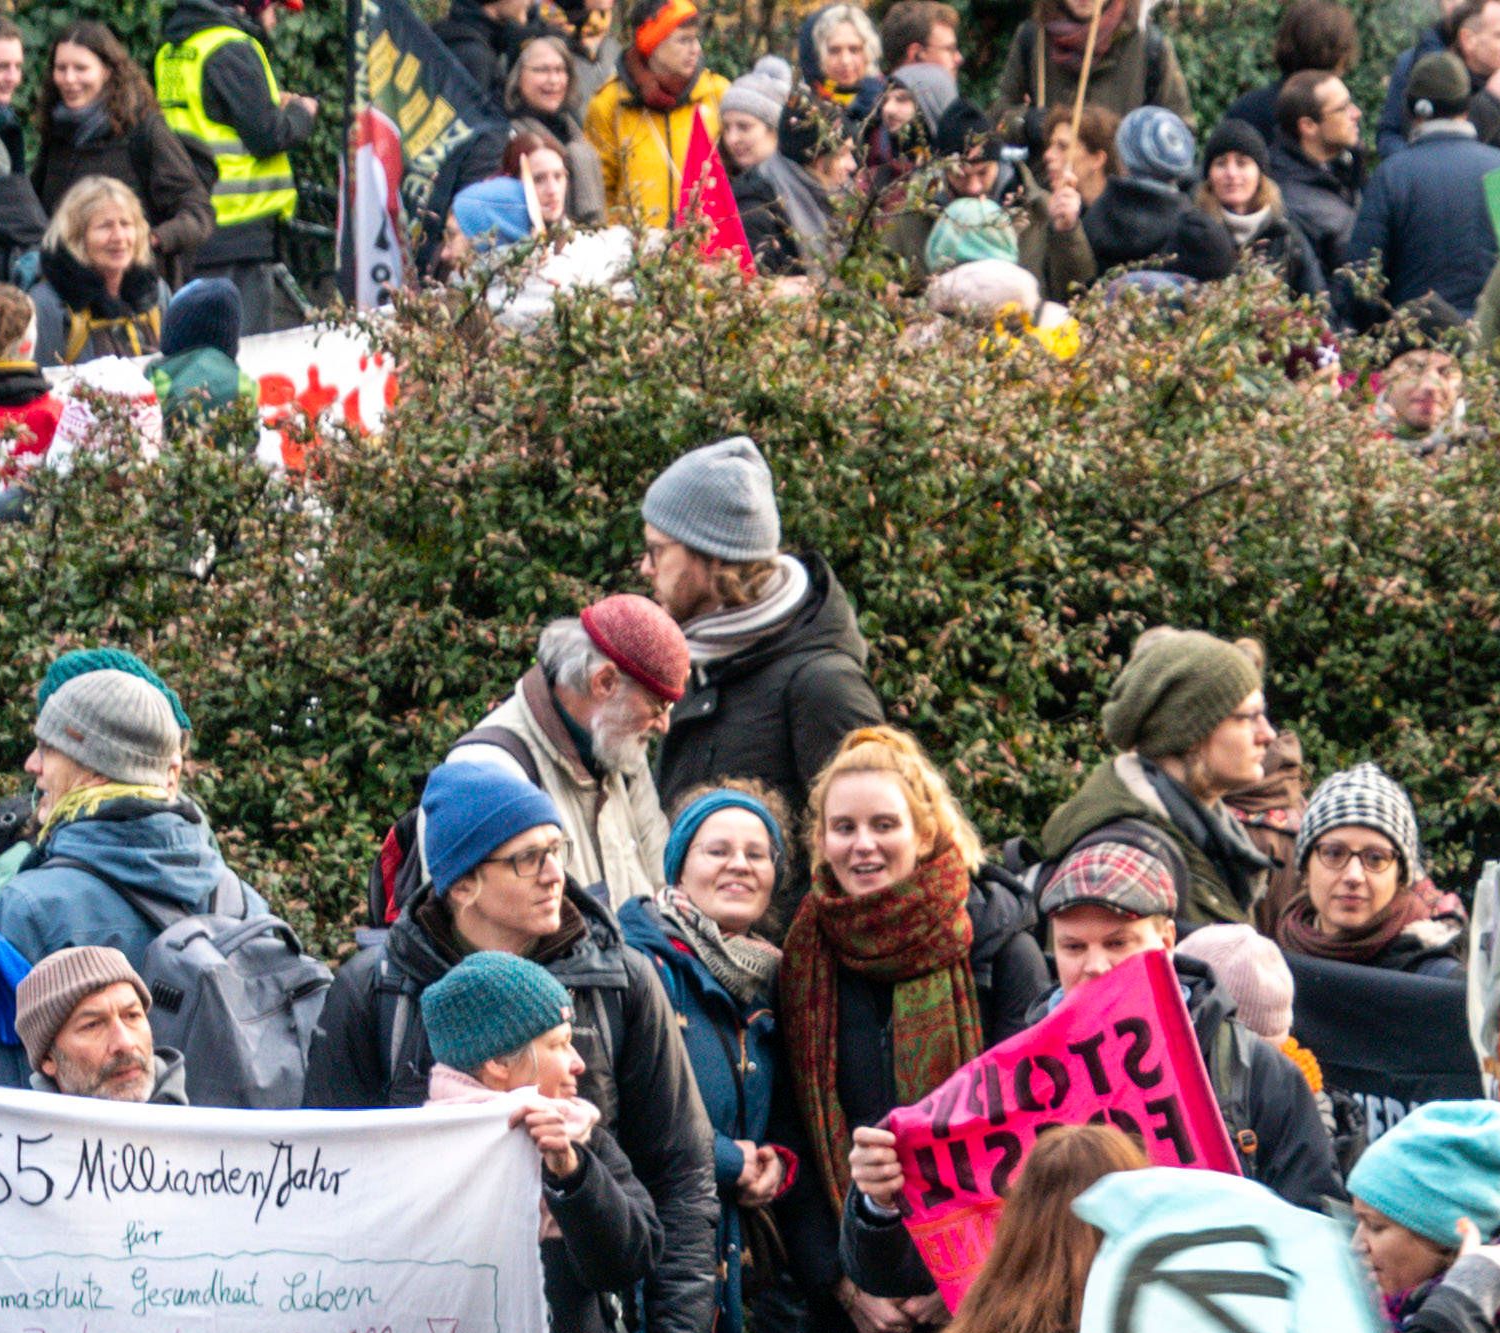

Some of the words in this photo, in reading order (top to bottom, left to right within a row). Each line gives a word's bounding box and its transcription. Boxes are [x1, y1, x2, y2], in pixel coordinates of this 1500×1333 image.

[121, 1220, 165, 1254] für
[130, 1265, 263, 1319] Gesundheit
[278, 1268, 379, 1313] Leben
